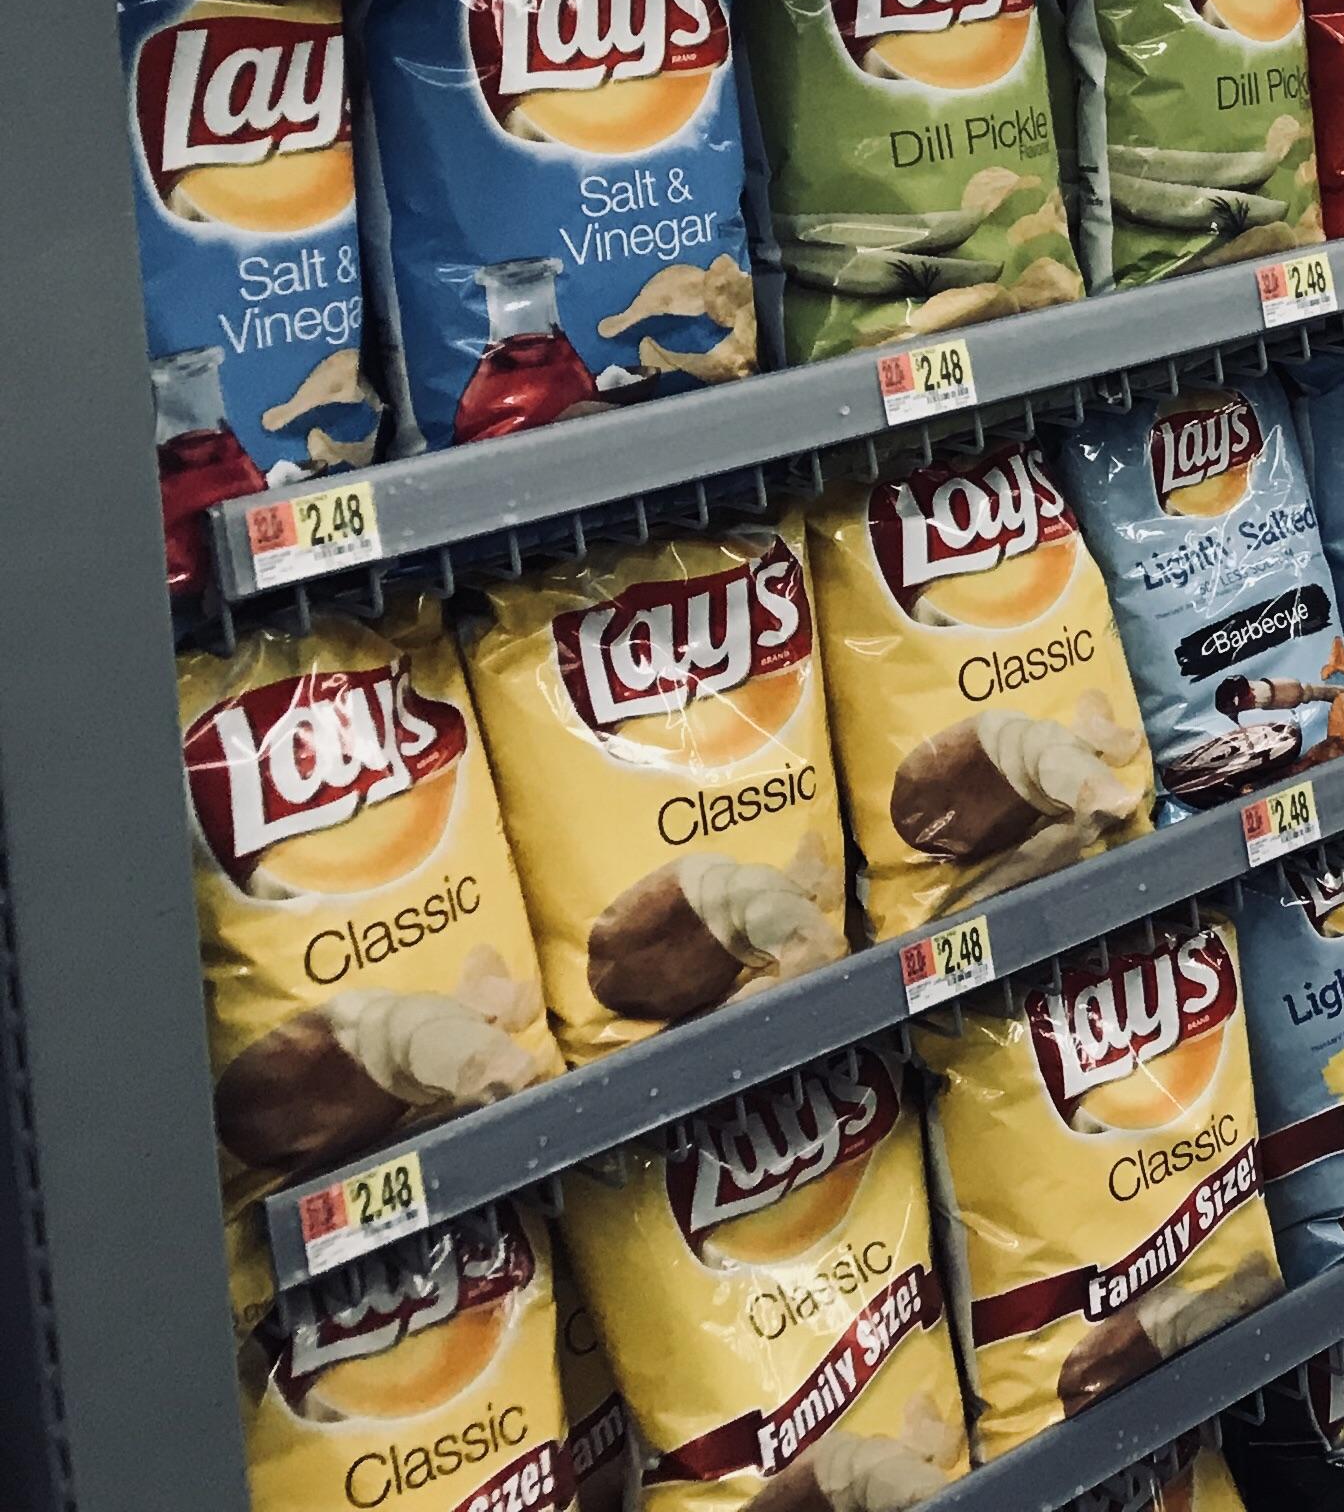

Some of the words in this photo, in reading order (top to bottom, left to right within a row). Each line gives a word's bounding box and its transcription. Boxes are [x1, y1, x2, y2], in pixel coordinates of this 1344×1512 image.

[1216, 71, 1259, 110] Dill
[889, 123, 952, 168] Dill
[967, 107, 1048, 156] Pickle
[580, 173, 657, 216] Salt
[666, 168, 693, 201] &
[238, 254, 325, 301] Salt
[336, 246, 356, 283] &
[560, 209, 718, 265] Vinegar
[1238, 508, 1316, 549] Salted
[1214, 599, 1309, 652] Barbecue
[959, 626, 1096, 702] Classic
[658, 762, 817, 845] Classic
[303, 875, 481, 985] Classic
[1109, 1112, 1238, 1202] Classic
[1090, 1215, 1190, 1315] Family
[1196, 1143, 1257, 1230] Size!
[747, 1236, 893, 1340] Classic
[758, 1360, 860, 1471] Family
[855, 1277, 922, 1348] Size!
[344, 1403, 528, 1509] Classic
